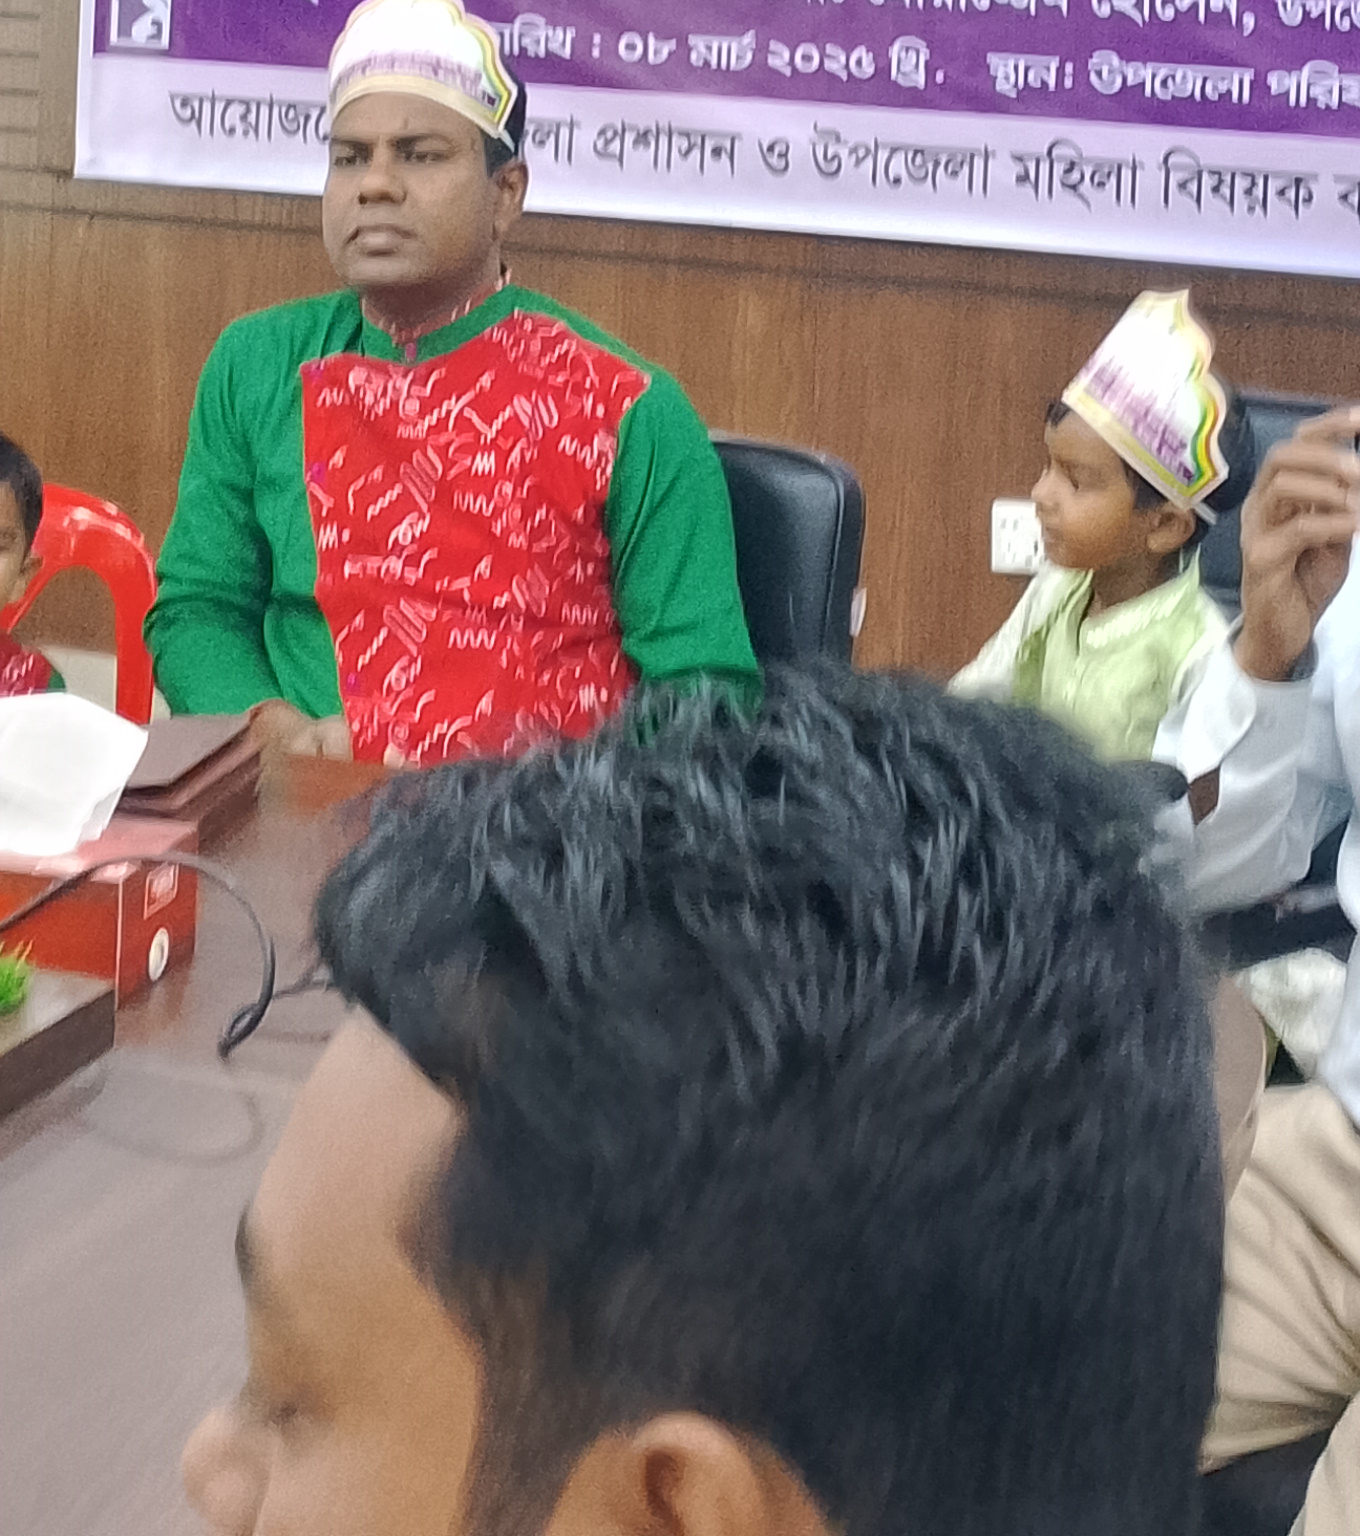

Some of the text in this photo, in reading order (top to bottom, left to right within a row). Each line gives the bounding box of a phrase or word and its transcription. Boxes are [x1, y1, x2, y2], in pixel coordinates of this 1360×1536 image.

[1087, 49, 1255, 106] উপজেলা
[594, 117, 743, 181] প্রশাসন
[758, 140, 792, 178] ও
[810, 118, 997, 199] উপজেলা
[1008, 138, 1147, 213] মহিলা
